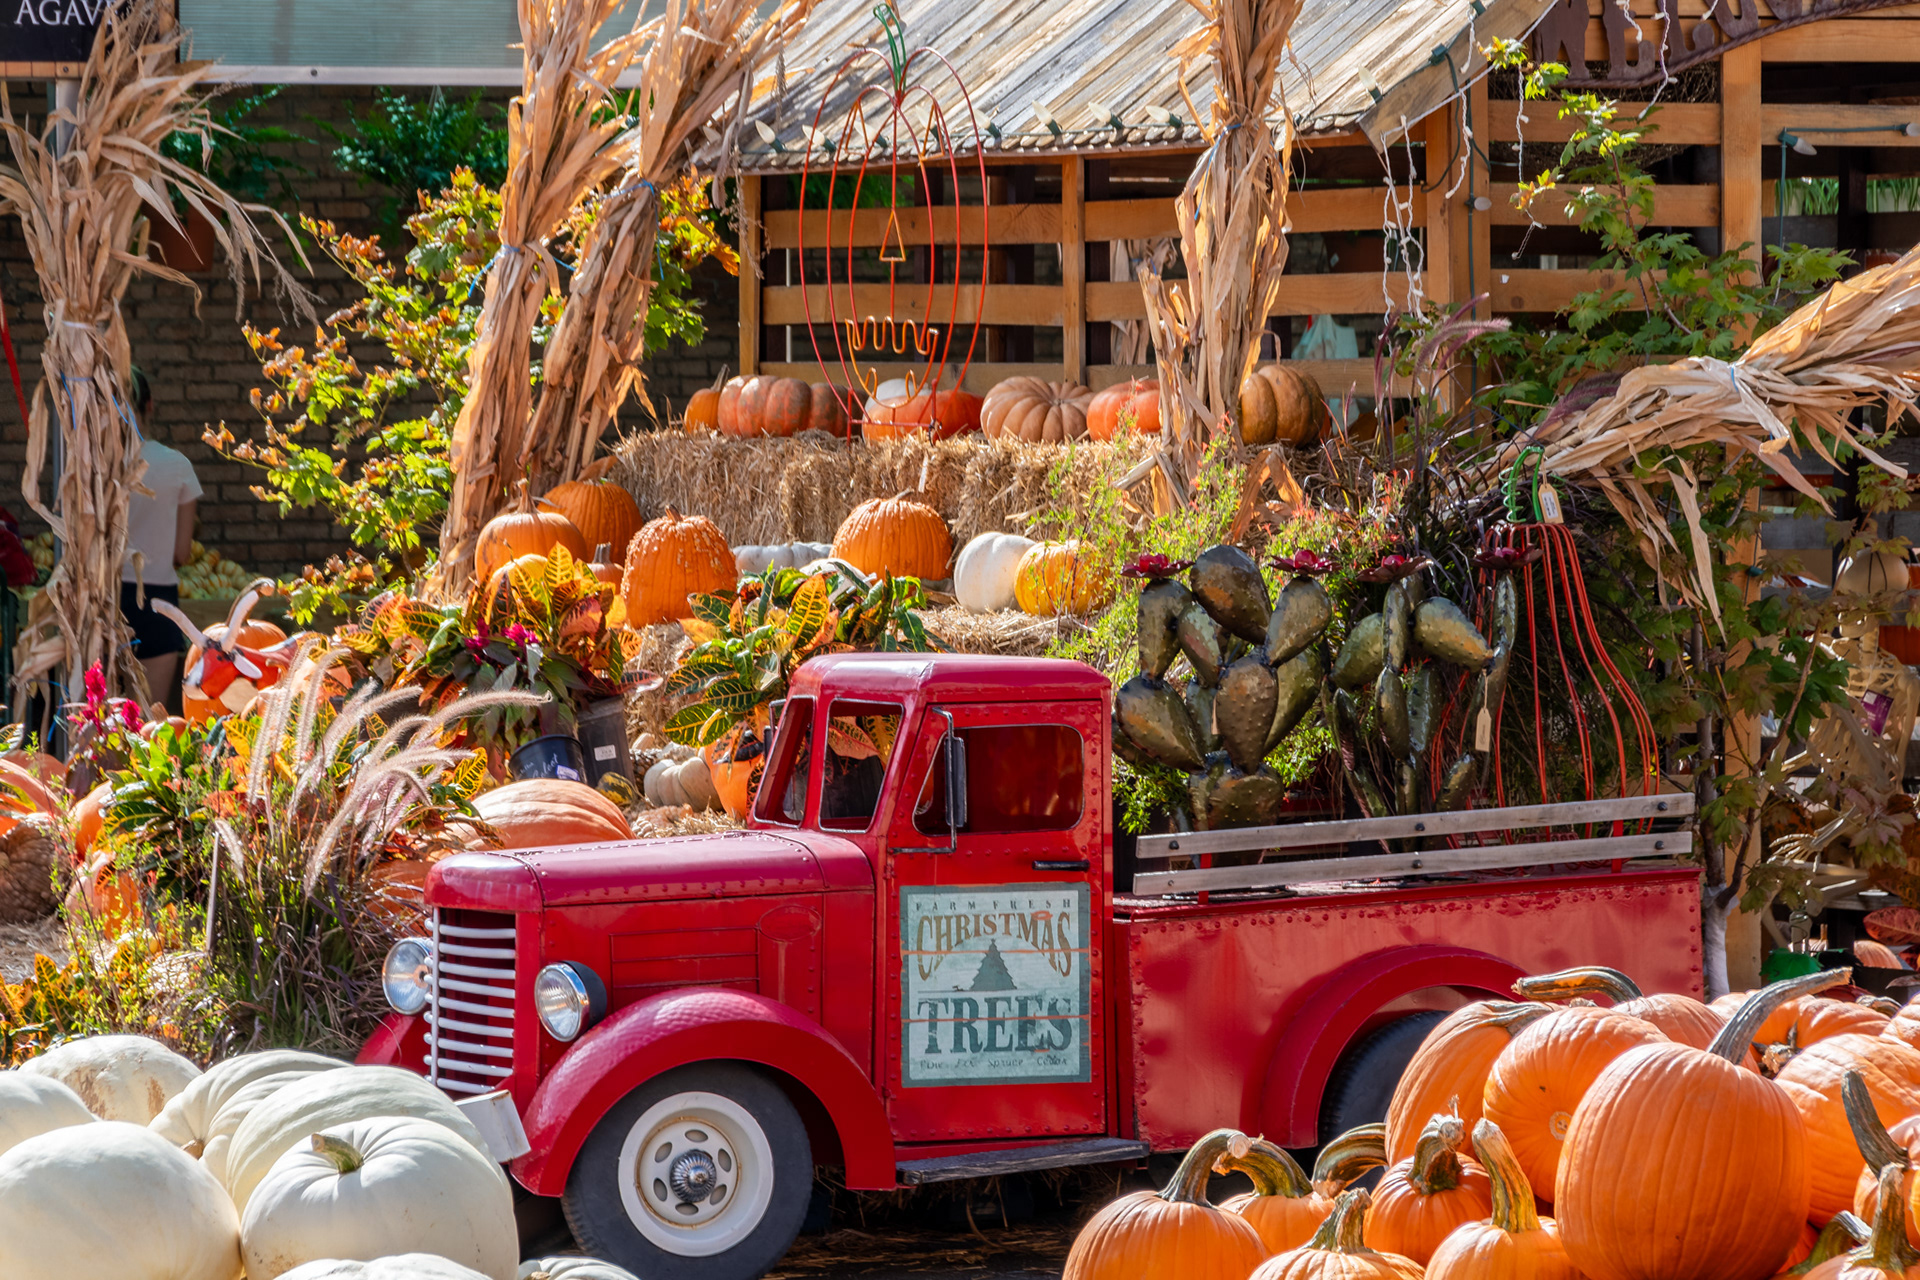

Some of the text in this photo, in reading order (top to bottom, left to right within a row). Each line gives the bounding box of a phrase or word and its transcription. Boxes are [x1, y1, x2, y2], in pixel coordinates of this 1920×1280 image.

[14, 0, 118, 25] AGAV
[916, 899, 1071, 911] FARM FRESH
[916, 911, 1072, 981] CHRISTMAS
[917, 995, 1072, 1054] TREES
